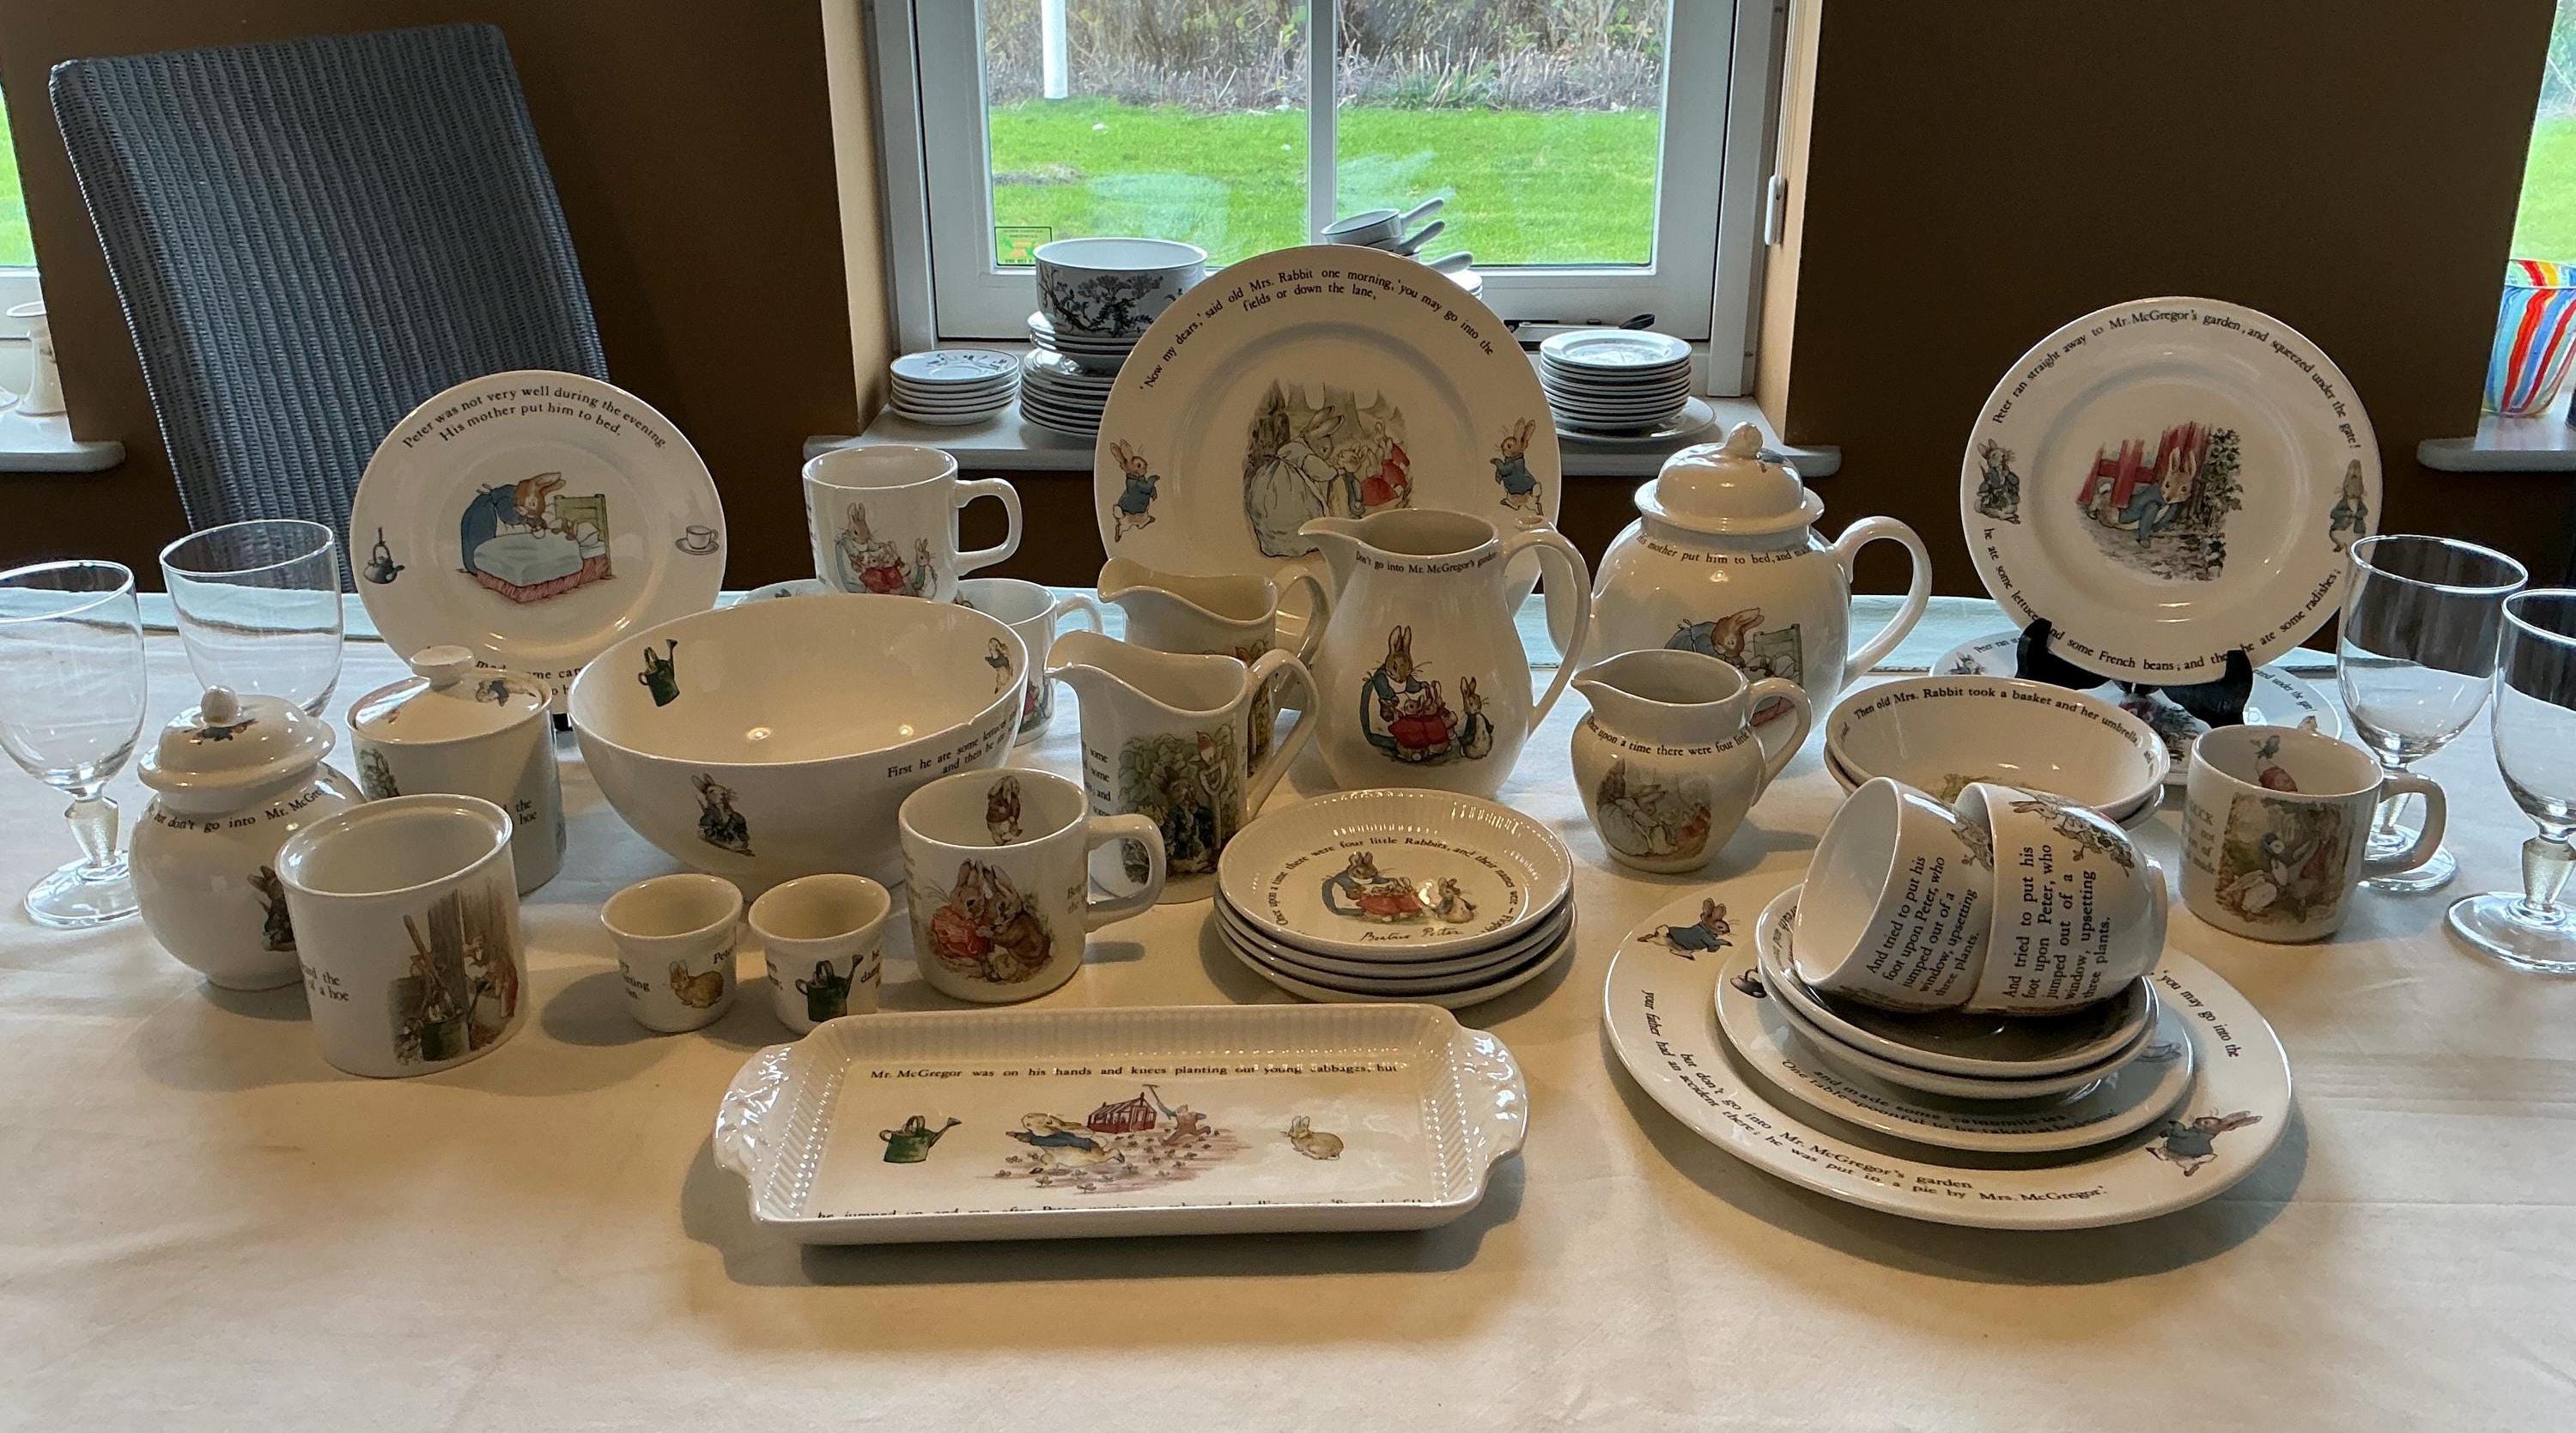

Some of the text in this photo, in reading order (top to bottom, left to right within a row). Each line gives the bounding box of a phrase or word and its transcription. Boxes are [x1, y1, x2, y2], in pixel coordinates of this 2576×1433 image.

[1242, 282, 1376, 312] fields or down the lane,
[1163, 347, 1177, 362] my
[1205, 300, 1223, 319] said
[1228, 288, 1244, 303] old
[1249, 278, 1274, 292] Mrs.
[1279, 268, 1313, 283] Rabbit
[1321, 269, 1340, 278] one
[1347, 271, 1394, 291] morning,
[1420, 294, 1442, 312] may
[1444, 310, 1458, 322] go
[1461, 320, 1479, 339] into
[1479, 339, 1495, 355] the
[1993, 398, 2014, 424] Peter
[2013, 381, 2027, 398] ran
[2027, 351, 2061, 381] straight
[2063, 334, 2087, 354] away
[2092, 326, 2104, 337] to
[2109, 316, 2130, 331] Mr.
[2132, 309, 2197, 323] McGregor's
[2247, 327, 2269, 342] and
[2270, 340, 2314, 373] squeezed
[2312, 373, 2336, 399] under
[2332, 400, 2347, 418] the
[402, 421, 434, 447] Peter
[435, 406, 459, 423] was
[462, 397, 483, 412] not
[487, 389, 516, 402] very
[522, 386, 550, 397] well
[554, 387, 598, 407] during
[601, 400, 623, 417] the
[439, 424, 465, 441] His
[467, 406, 516, 423] mother
[520, 402, 544, 415] put
[549, 402, 574, 416] him
[579, 409, 592, 421] to
[1984, 527, 1995, 541] he
[1388, 563, 1405, 572] into
[1409, 564, 1424, 574] Mr.
[1427, 560, 1475, 574] McGregor's
[1648, 542, 1678, 557] mother
[1680, 552, 1699, 562] put
[1705, 554, 1728, 564] him
[1776, 551, 1791, 562] and
[1988, 546, 1999, 560] ate
[1996, 566, 2013, 589] some
[2011, 591, 2038, 621] lettuce
[2280, 611, 2306, 633] some
[2067, 638, 2094, 657] some
[2241, 644, 2255, 653] he
[2260, 632, 2275, 645] ate
[2099, 651, 2136, 668] French
[2184, 657, 2205, 670] and
[1854, 704, 1874, 720] Then
[1877, 695, 1891, 709] old
[1894, 694, 1919, 703] Mrs.
[1923, 687, 1964, 698] Rabbit
[1969, 689, 1995, 697] took
[2013, 690, 2052, 705] basket
[2055, 701, 2077, 713] and
[2081, 706, 2099, 720] her
[887, 740, 979, 778] First he ate some
[1629, 740, 1734, 756] time there were four
[943, 758, 960, 774] and
[167, 808, 289, 833] don't go into Mr.
[1866, 856, 1926, 974] And tried to put his
[1882, 857, 1945, 981] foot upon Peter, who
[2003, 847, 2038, 998] And tried to put his
[2021, 845, 2055, 999] foot upon Peter, who
[1902, 899, 1951, 987] jumped out of
[1919, 890, 1978, 993] window, upsetting
[1954, 932, 1980, 971] plants.
[2043, 892, 2073, 999] jumped out of
[2065, 870, 2096, 999] window, upsetting
[2094, 917, 2111, 963] plants.
[2180, 991, 2232, 1041] may go into
[897, 1070, 963, 1078] McGregor
[1029, 1068, 1046, 1077] his
[1055, 1067, 1092, 1076] hands
[1175, 1066, 1228, 1076] planting
[1680, 1053, 1697, 1067] but
[1722, 1100, 1741, 1110] go
[1745, 1112, 1771, 1129] into
[1779, 1132, 1805, 1147] Mr.
[1809, 1145, 1905, 1178] McGregor's
[1916, 1176, 1972, 1188] garden
[1791, 1148, 1817, 1162] was
[1826, 1163, 1854, 1175] put
[1947, 1188, 1965, 1199] by
[1979, 1192, 2018, 1201] Mrs.
